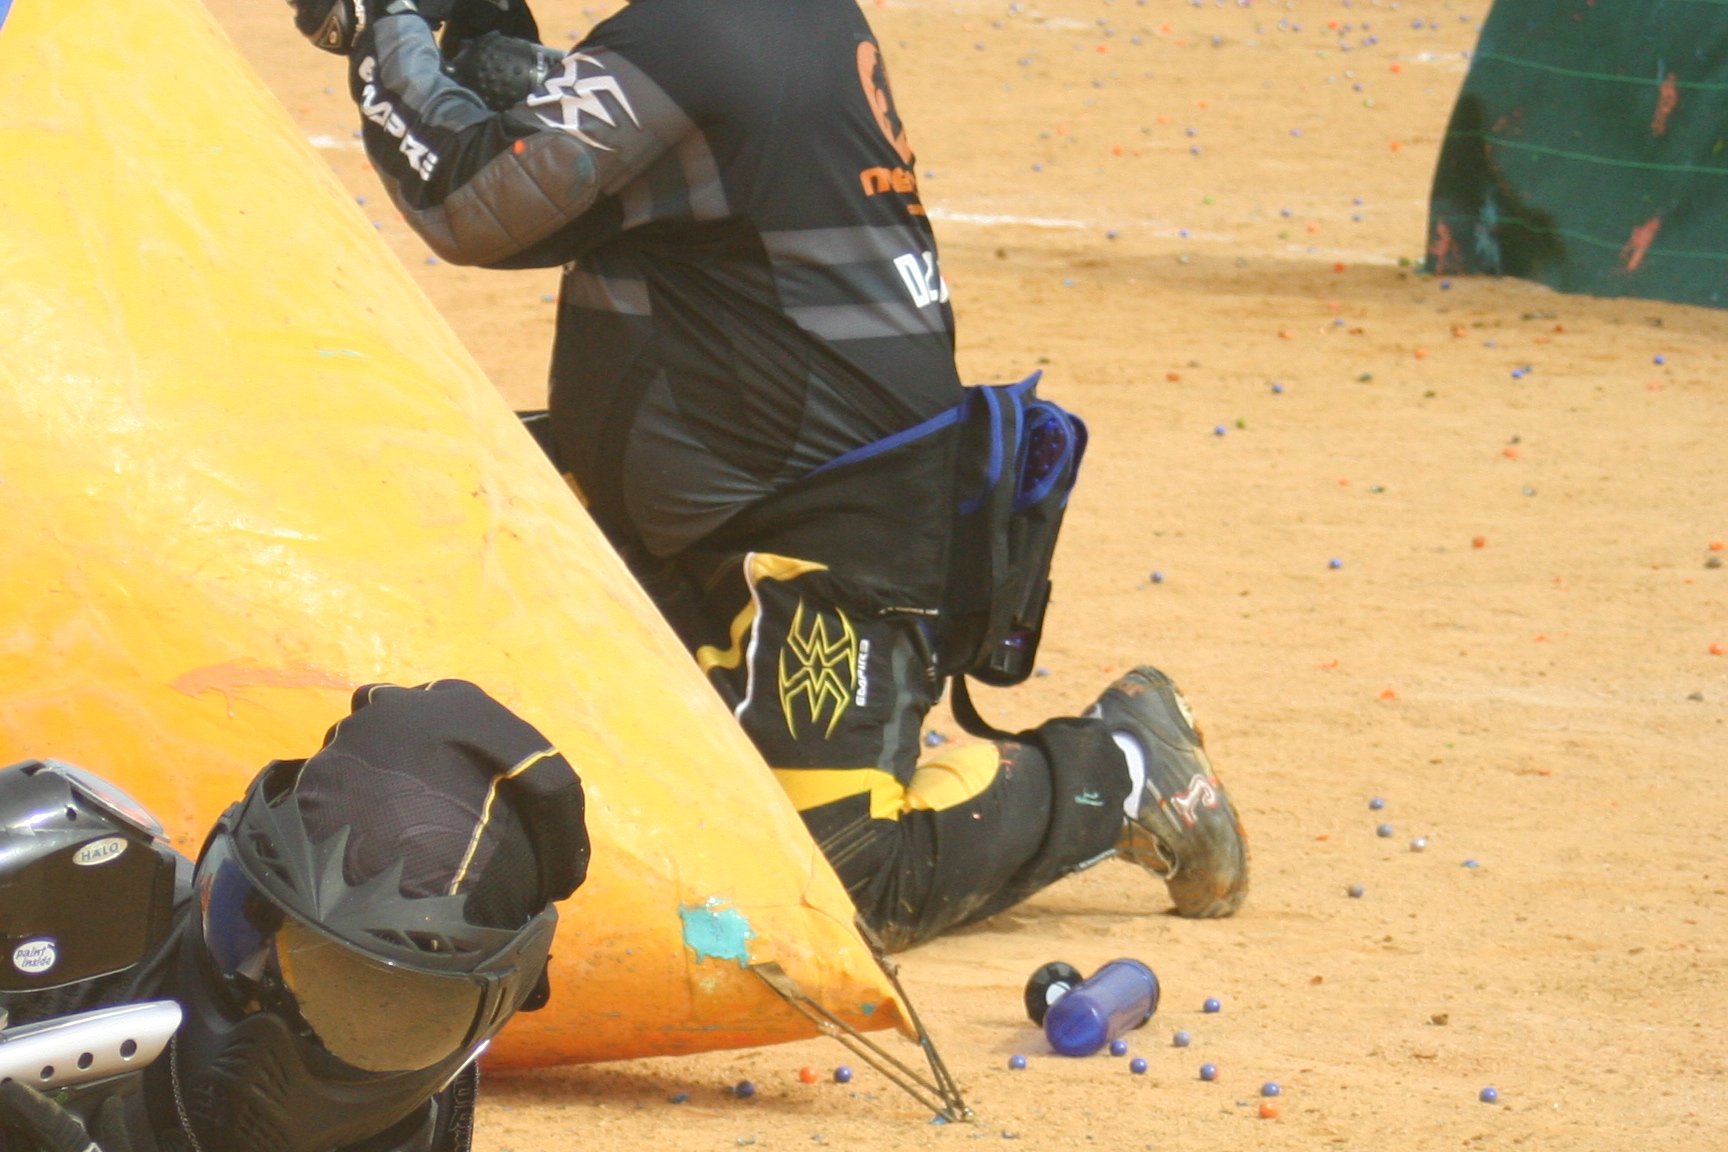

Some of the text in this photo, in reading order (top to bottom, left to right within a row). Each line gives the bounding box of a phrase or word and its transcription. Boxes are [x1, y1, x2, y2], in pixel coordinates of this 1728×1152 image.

[856, 638, 870, 707] EMPIRE
[81, 842, 119, 862] HALO
[16, 947, 46, 959] paint
[22, 956, 52, 968] inside
